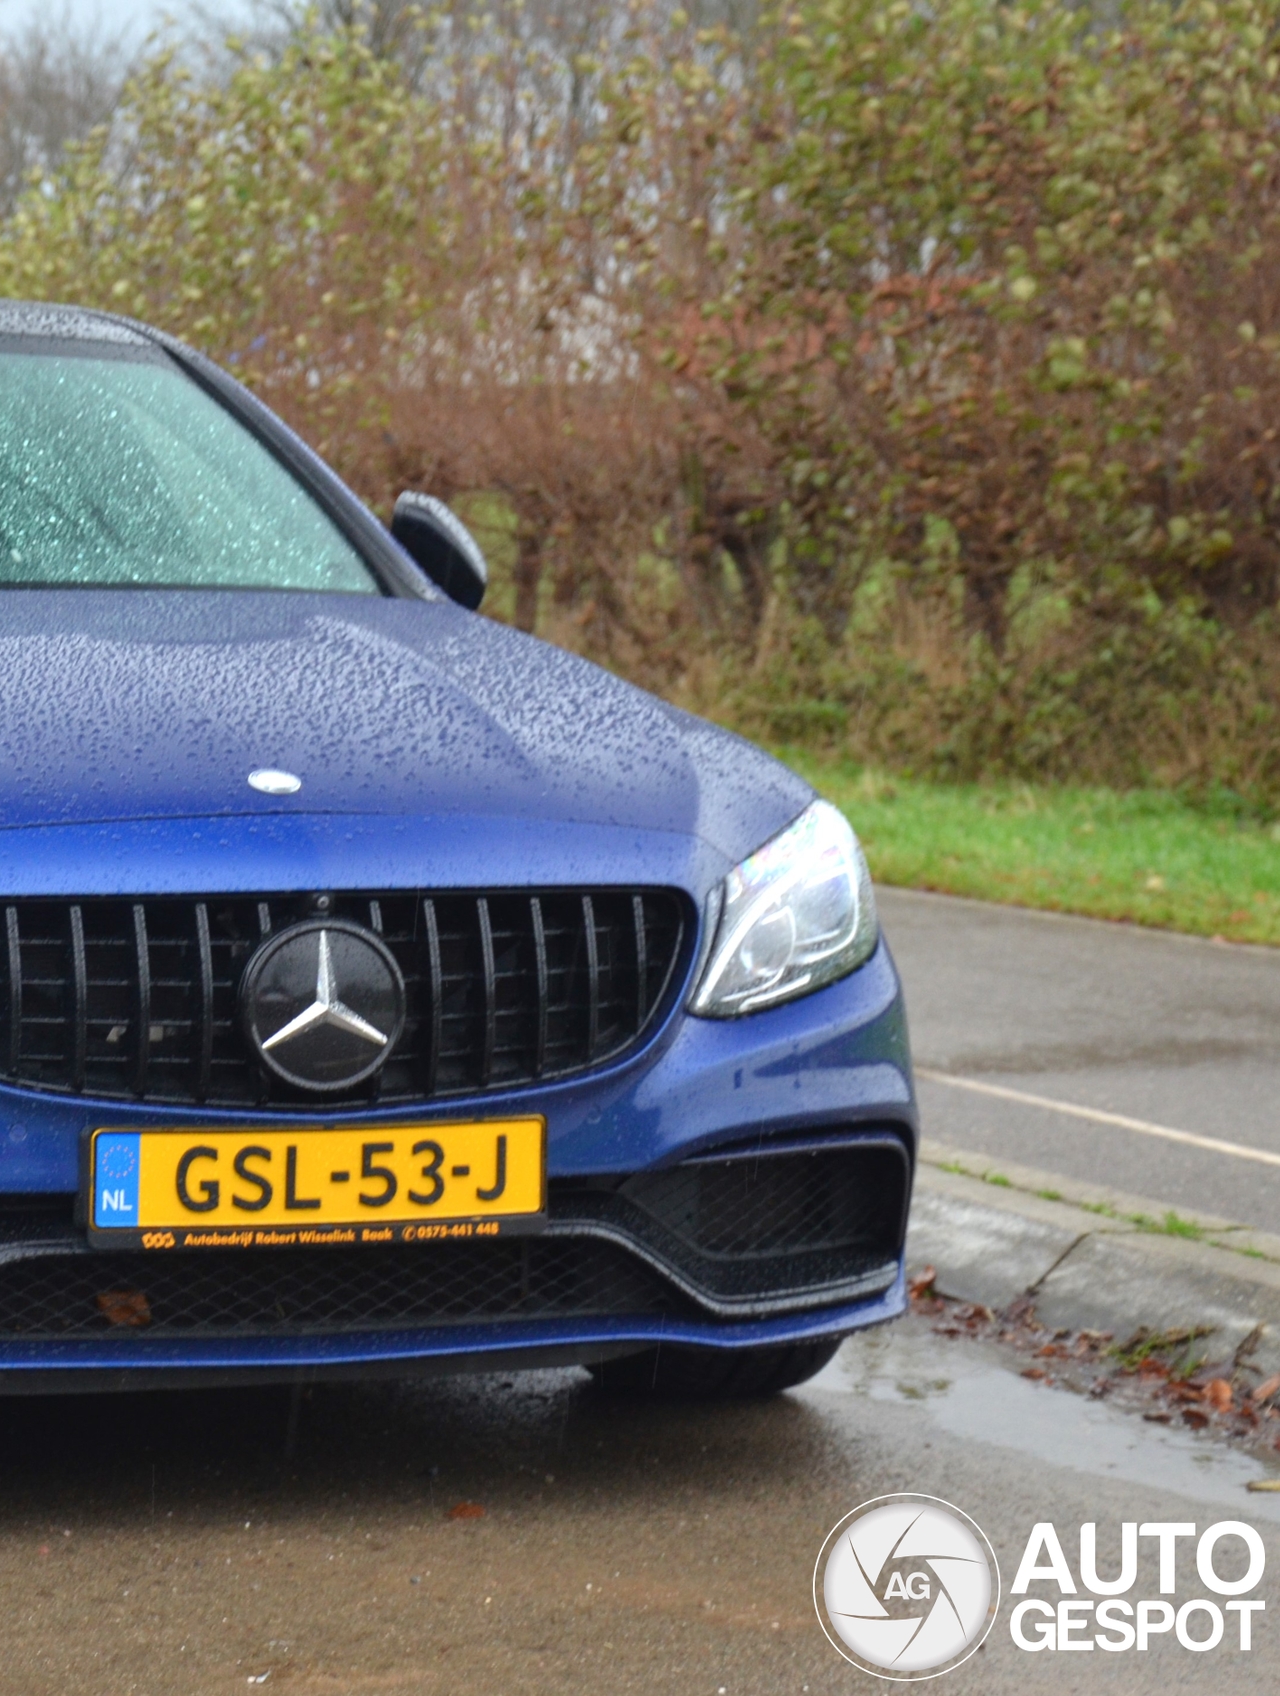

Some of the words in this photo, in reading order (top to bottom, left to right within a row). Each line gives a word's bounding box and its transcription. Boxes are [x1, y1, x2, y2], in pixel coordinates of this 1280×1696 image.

[175, 1134, 507, 1213] GSL-53-J
[102, 1190, 132, 1212] NL
[184, 1229, 253, 1248] Autobedrijf
[255, 1231, 297, 1245] Robert
[298, 1228, 356, 1244] Wisselink
[361, 1227, 393, 1241] Baak
